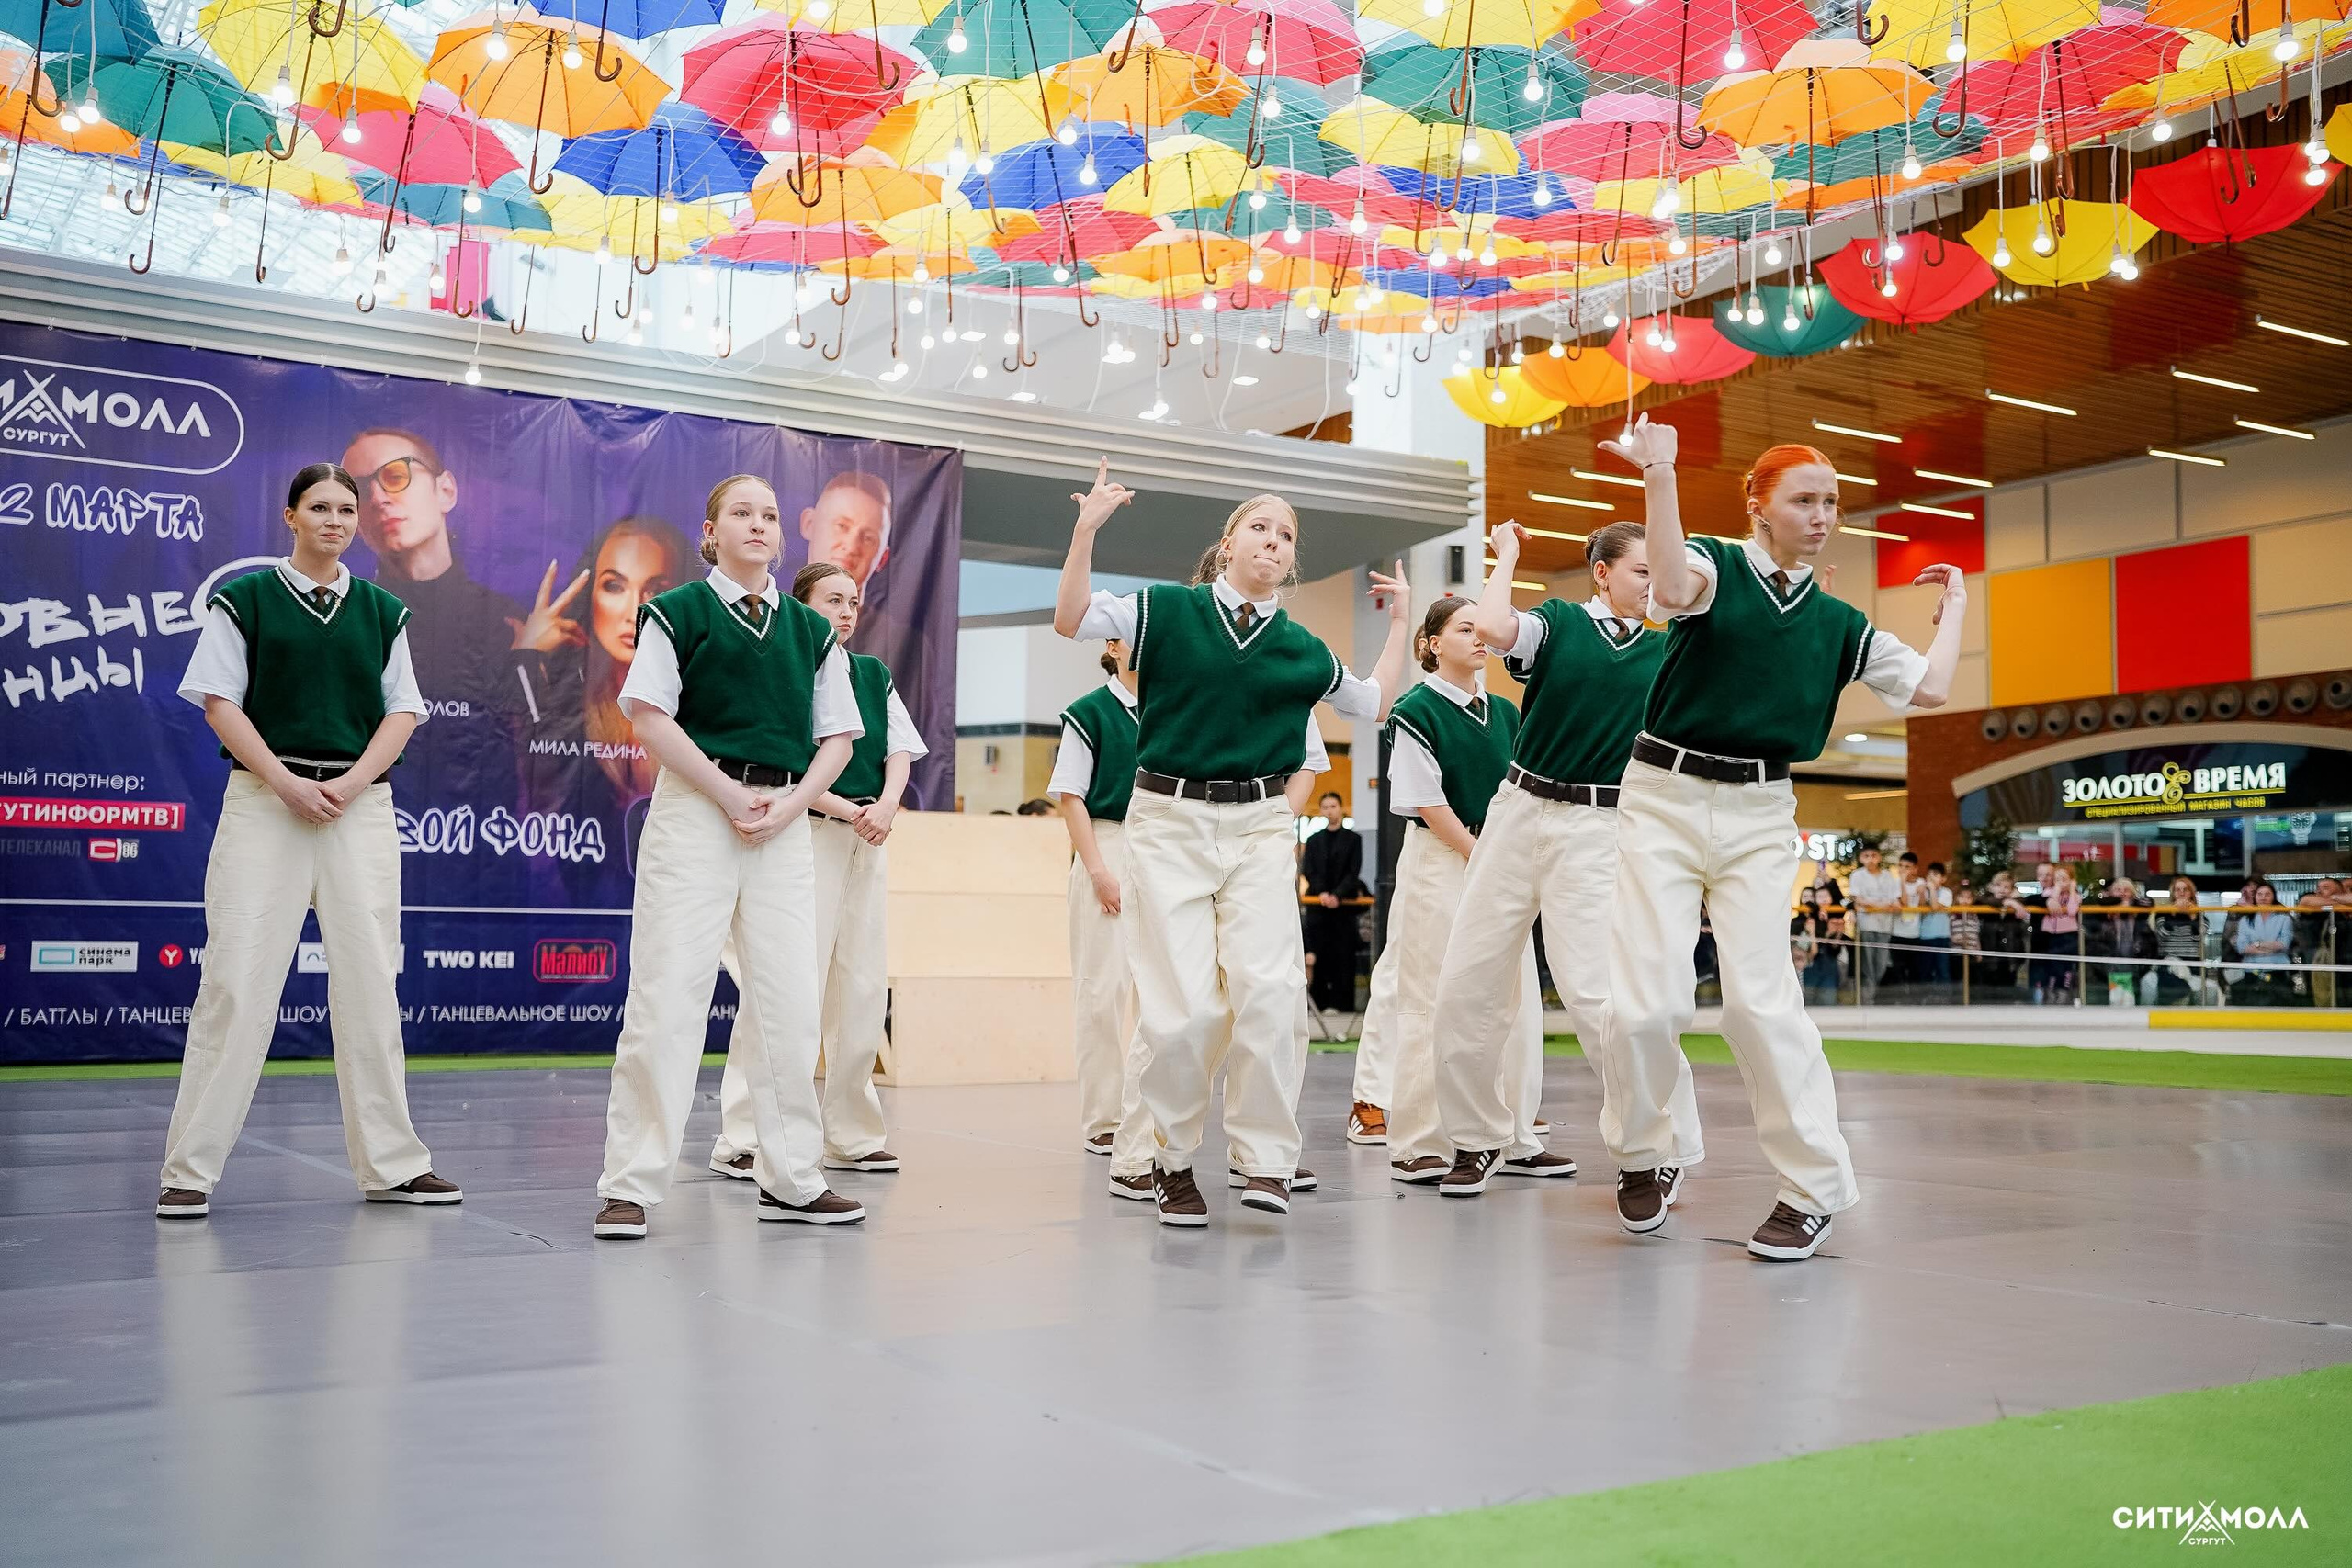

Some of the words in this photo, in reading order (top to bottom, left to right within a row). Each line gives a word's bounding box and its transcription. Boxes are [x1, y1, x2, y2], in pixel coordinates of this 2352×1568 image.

[62, 385, 212, 438] МОЛЛ
[3, 426, 71, 446] СУРГУТ
[46, 482, 204, 542] МАРТА
[529, 739, 580, 757] МИЛА
[583, 741, 647, 761] РЕДИНА
[44, 772, 145, 794] партнер:
[2193, 762, 2287, 794] ВРЕМЯ
[480, 806, 606, 863] ФОНД
[423, 950, 476, 969] TWO
[479, 950, 515, 969] KEI
[20, 1007, 98, 1025] БАТТЛЫ
[279, 1006, 328, 1023] ШОУ
[431, 1006, 566, 1024] ТАНЦЕВАЛЬНОЕ
[570, 1005, 613, 1022] ШОУ
